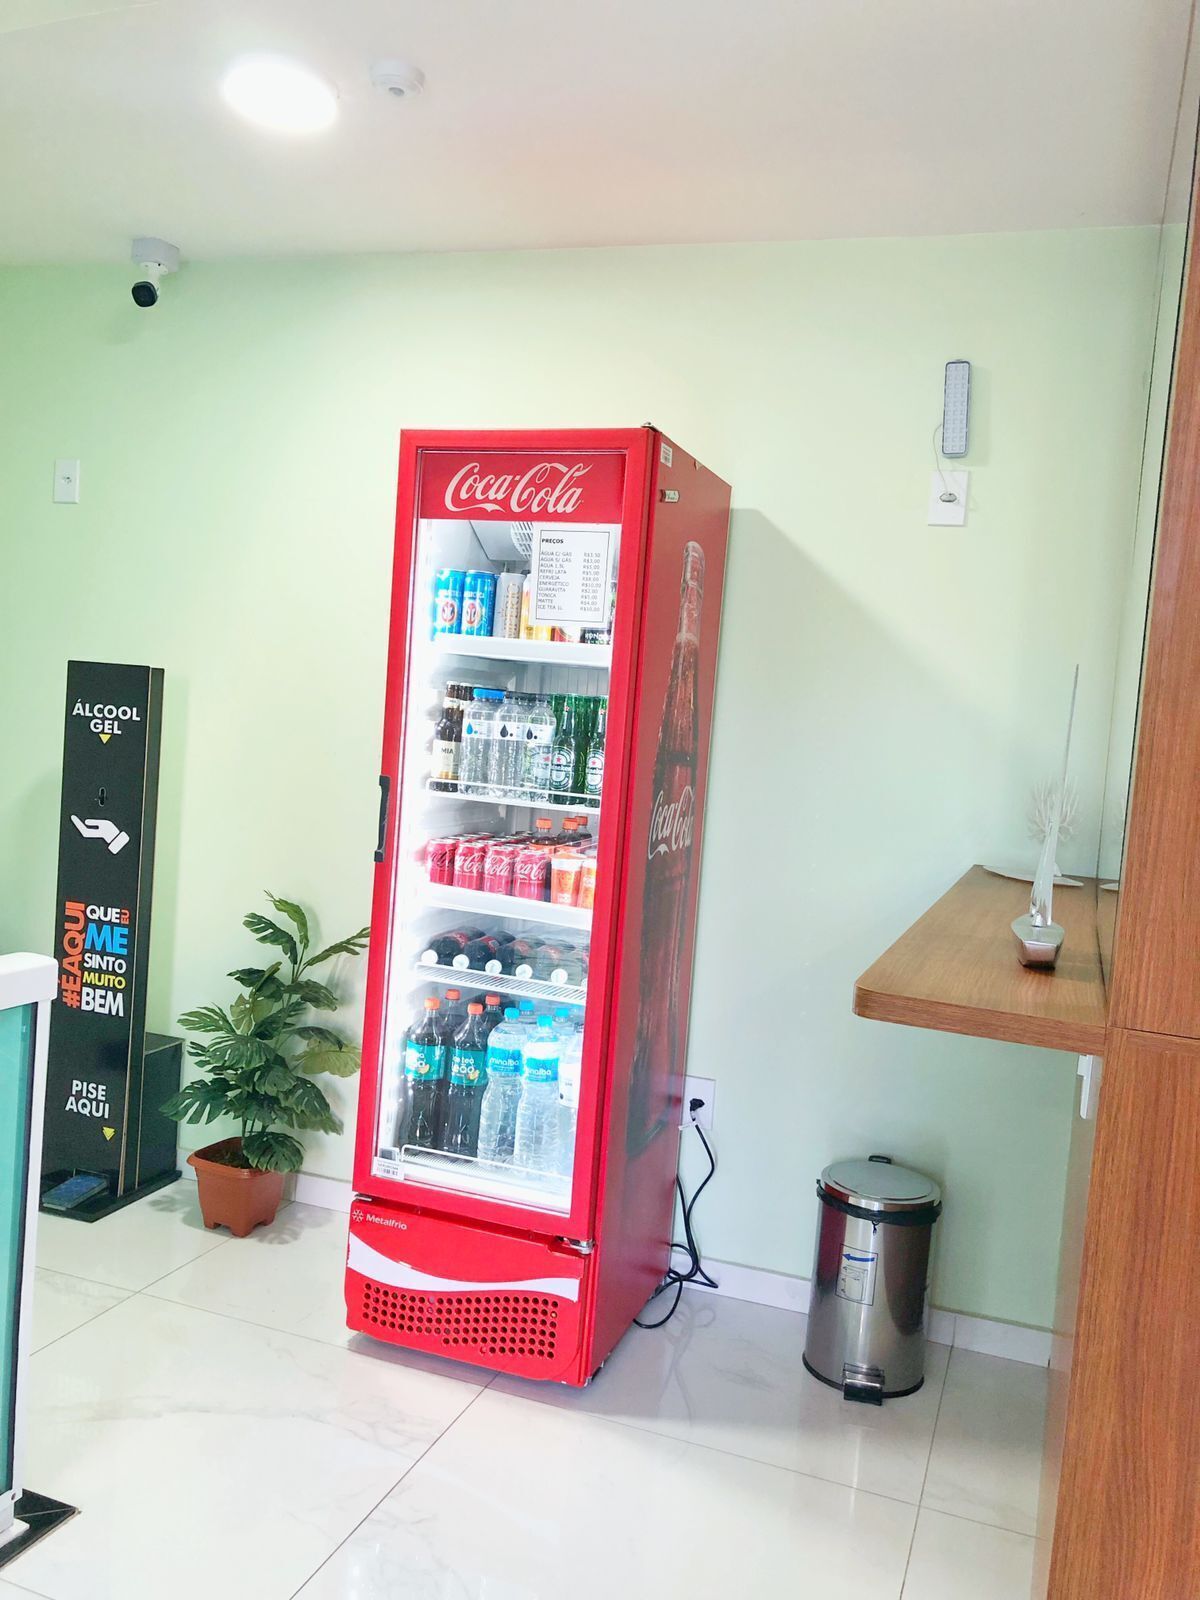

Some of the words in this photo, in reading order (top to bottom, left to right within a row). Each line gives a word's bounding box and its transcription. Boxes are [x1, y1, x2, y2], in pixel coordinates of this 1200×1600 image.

[444, 462, 593, 514] Coca-Cola
[72, 698, 141, 721] ÁLCOOL
[89, 718, 122, 735] GEL
[85, 904, 121, 924] QUE
[120, 909, 130, 925] EU
[84, 922, 129, 956] ME
[83, 952, 127, 974] SINTO
[82, 971, 127, 989] MUITO
[80, 986, 124, 1017] BEM
[71, 1079, 107, 1101] PISE
[64, 1096, 110, 1119] AQUI
[365, 1213, 408, 1231] Metalfrio
